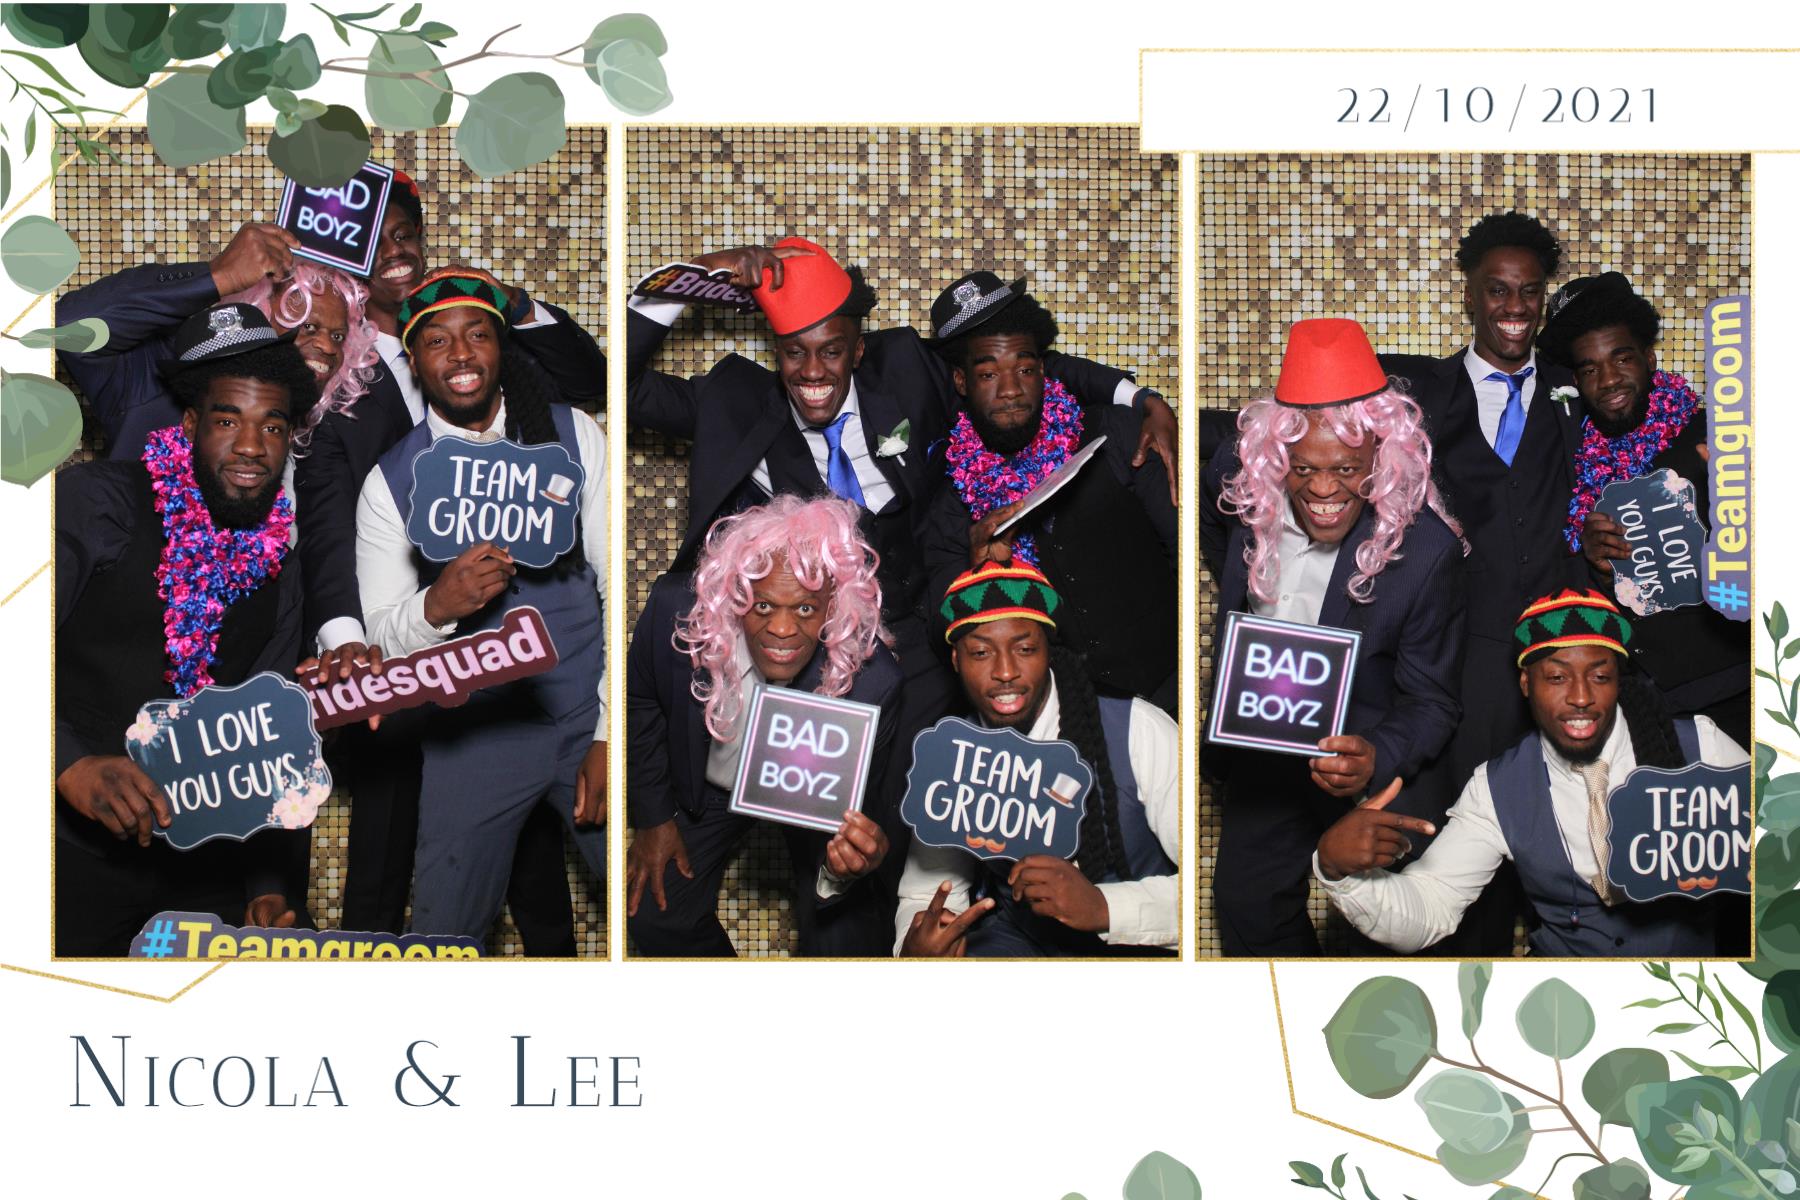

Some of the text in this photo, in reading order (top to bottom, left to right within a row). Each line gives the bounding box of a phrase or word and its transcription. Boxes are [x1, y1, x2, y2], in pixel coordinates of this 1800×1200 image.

[305, 179, 371, 210] AD
[297, 206, 362, 247] BOYZ
[644, 269, 757, 308] #Brides
[449, 456, 537, 502] TEAM
[1708, 302, 1752, 611] #Teamgroom
[428, 497, 554, 545] GROOM
[1652, 502, 1698, 584] I LOVE
[1617, 499, 1664, 600] YOU GUYS
[1244, 643, 1331, 686] BAD
[168, 702, 281, 764] I LOVE
[1238, 691, 1323, 727] BOYZ
[767, 713, 850, 758] BAD
[164, 753, 304, 815] YOU GUYS
[759, 761, 841, 801] BOYZ
[952, 739, 1042, 800] TEAM
[924, 780, 1057, 847] GROOM
[1645, 784, 1739, 832] TEAM
